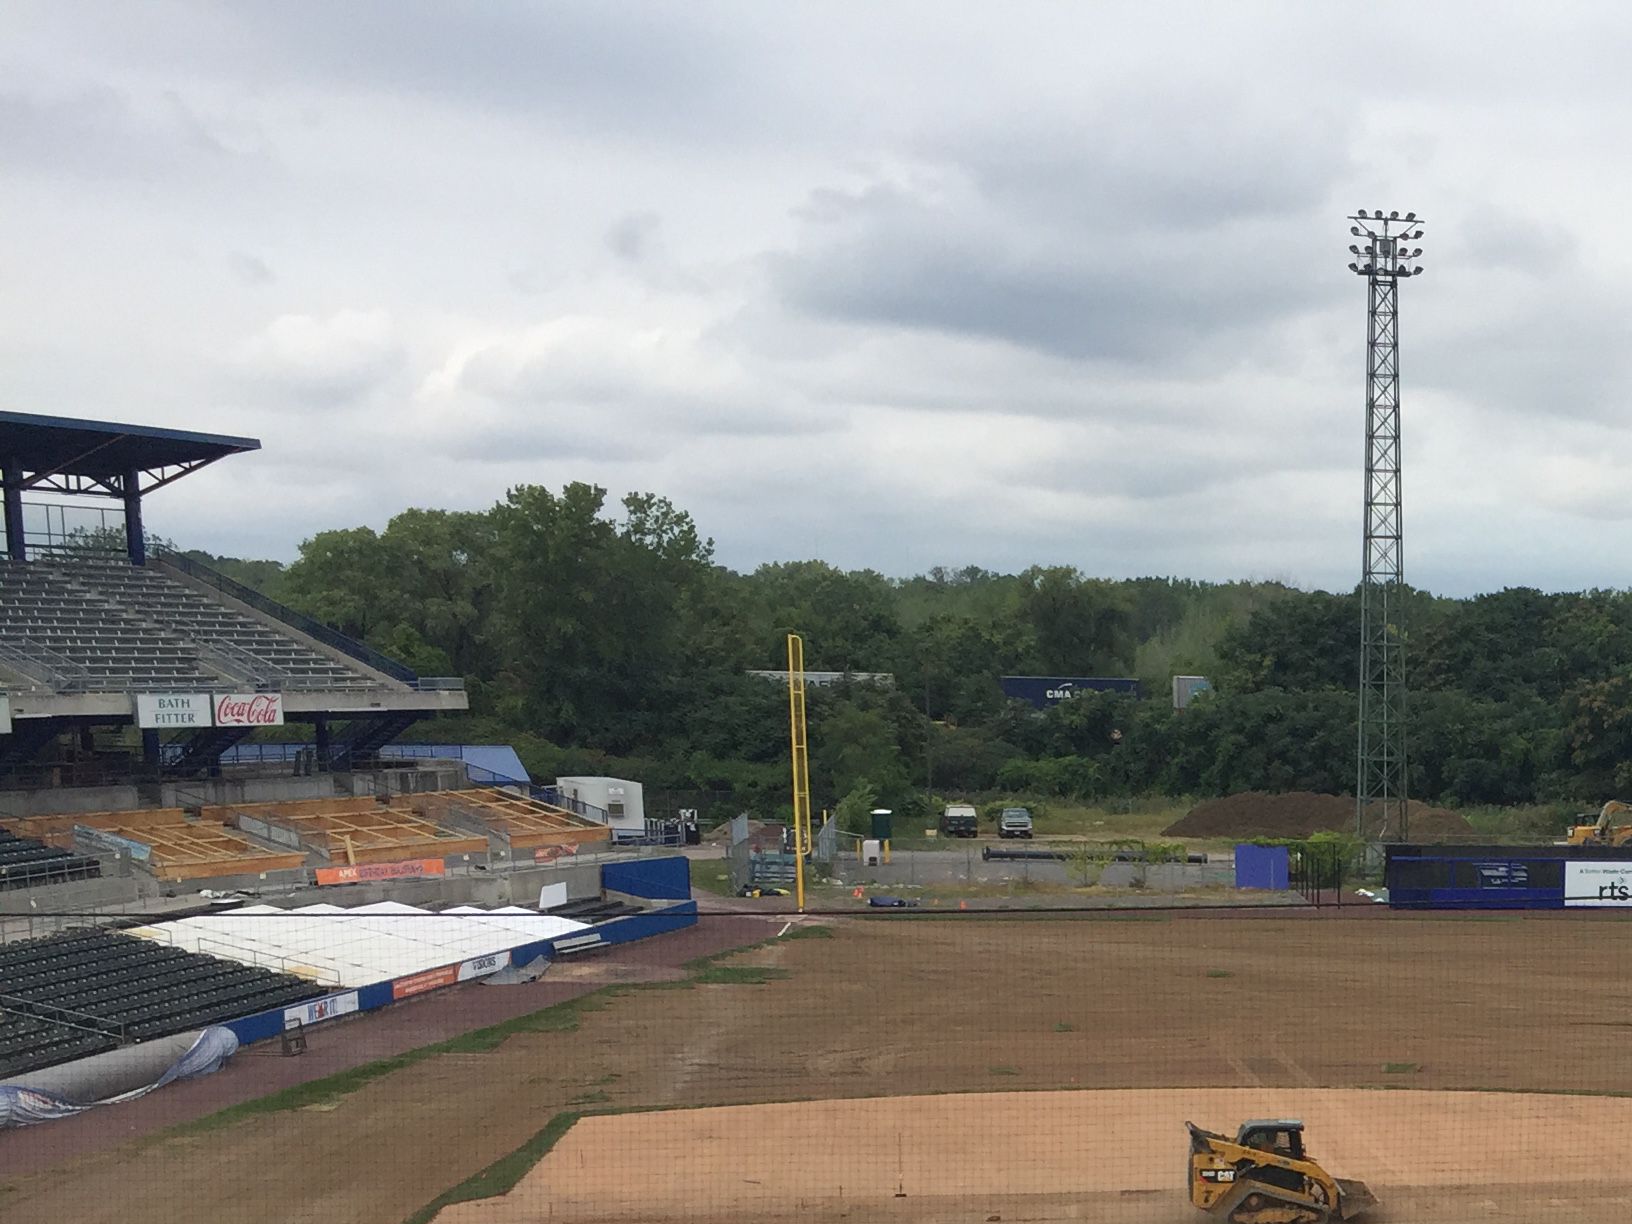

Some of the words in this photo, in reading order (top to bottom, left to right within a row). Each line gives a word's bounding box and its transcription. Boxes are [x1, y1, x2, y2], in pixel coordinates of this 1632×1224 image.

[1046, 689, 1072, 699] CMA
[158, 698, 191, 709] BATH
[154, 713, 196, 724] FITTER
[1599, 882, 1630, 901] rts
[1217, 1170, 1235, 1182] CAT
